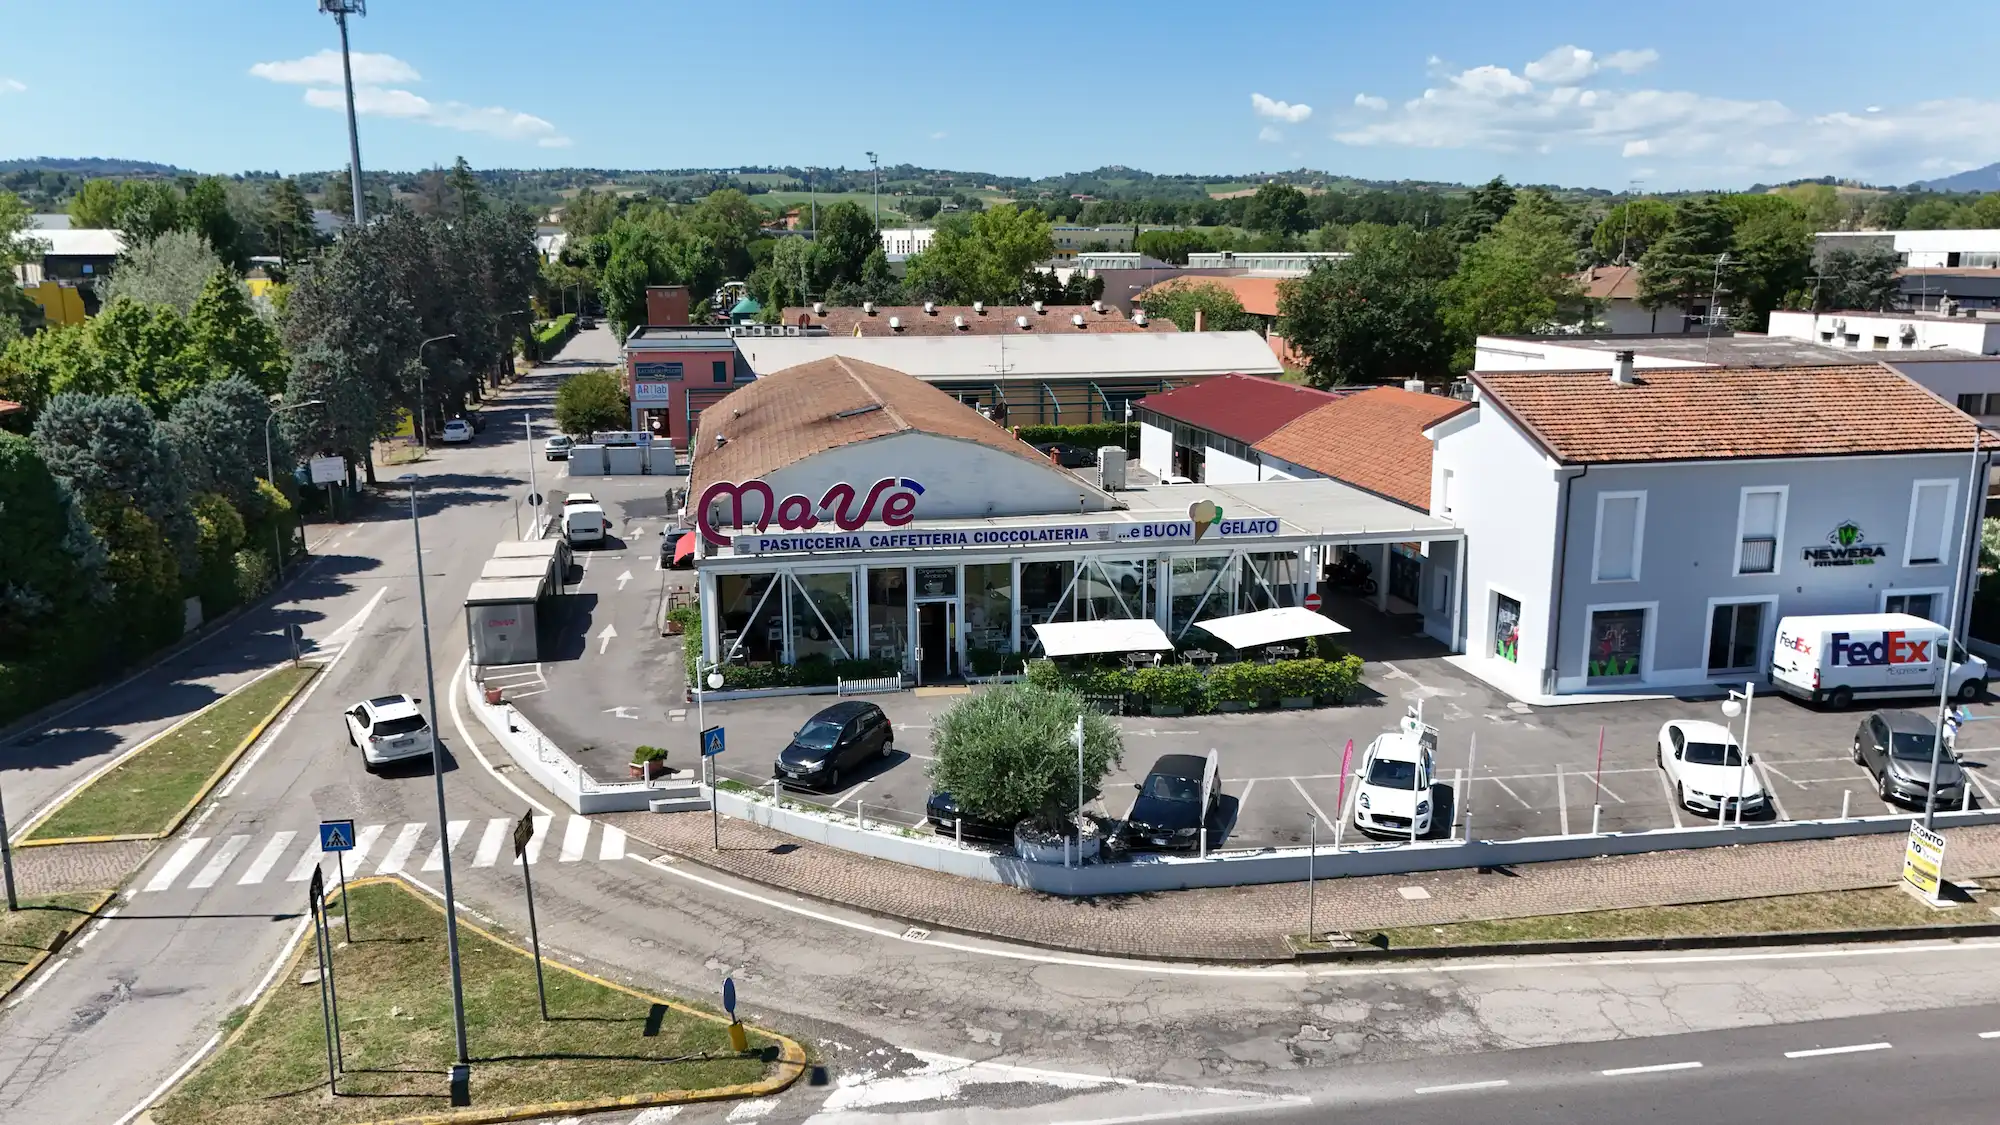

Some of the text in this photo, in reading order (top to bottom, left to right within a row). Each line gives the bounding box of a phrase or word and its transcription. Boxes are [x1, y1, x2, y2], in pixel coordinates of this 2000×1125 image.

[760, 528, 1089, 551] PASTICCERIA CAFFETTERIA CIOCCOLATERIA
[1143, 523, 1191, 538] BUON
[1220, 520, 1278, 535] GELATO
[1780, 632, 1812, 655] FedEx
[1831, 631, 1930, 666] FedEx
[1913, 823, 1944, 847] SCONTO
